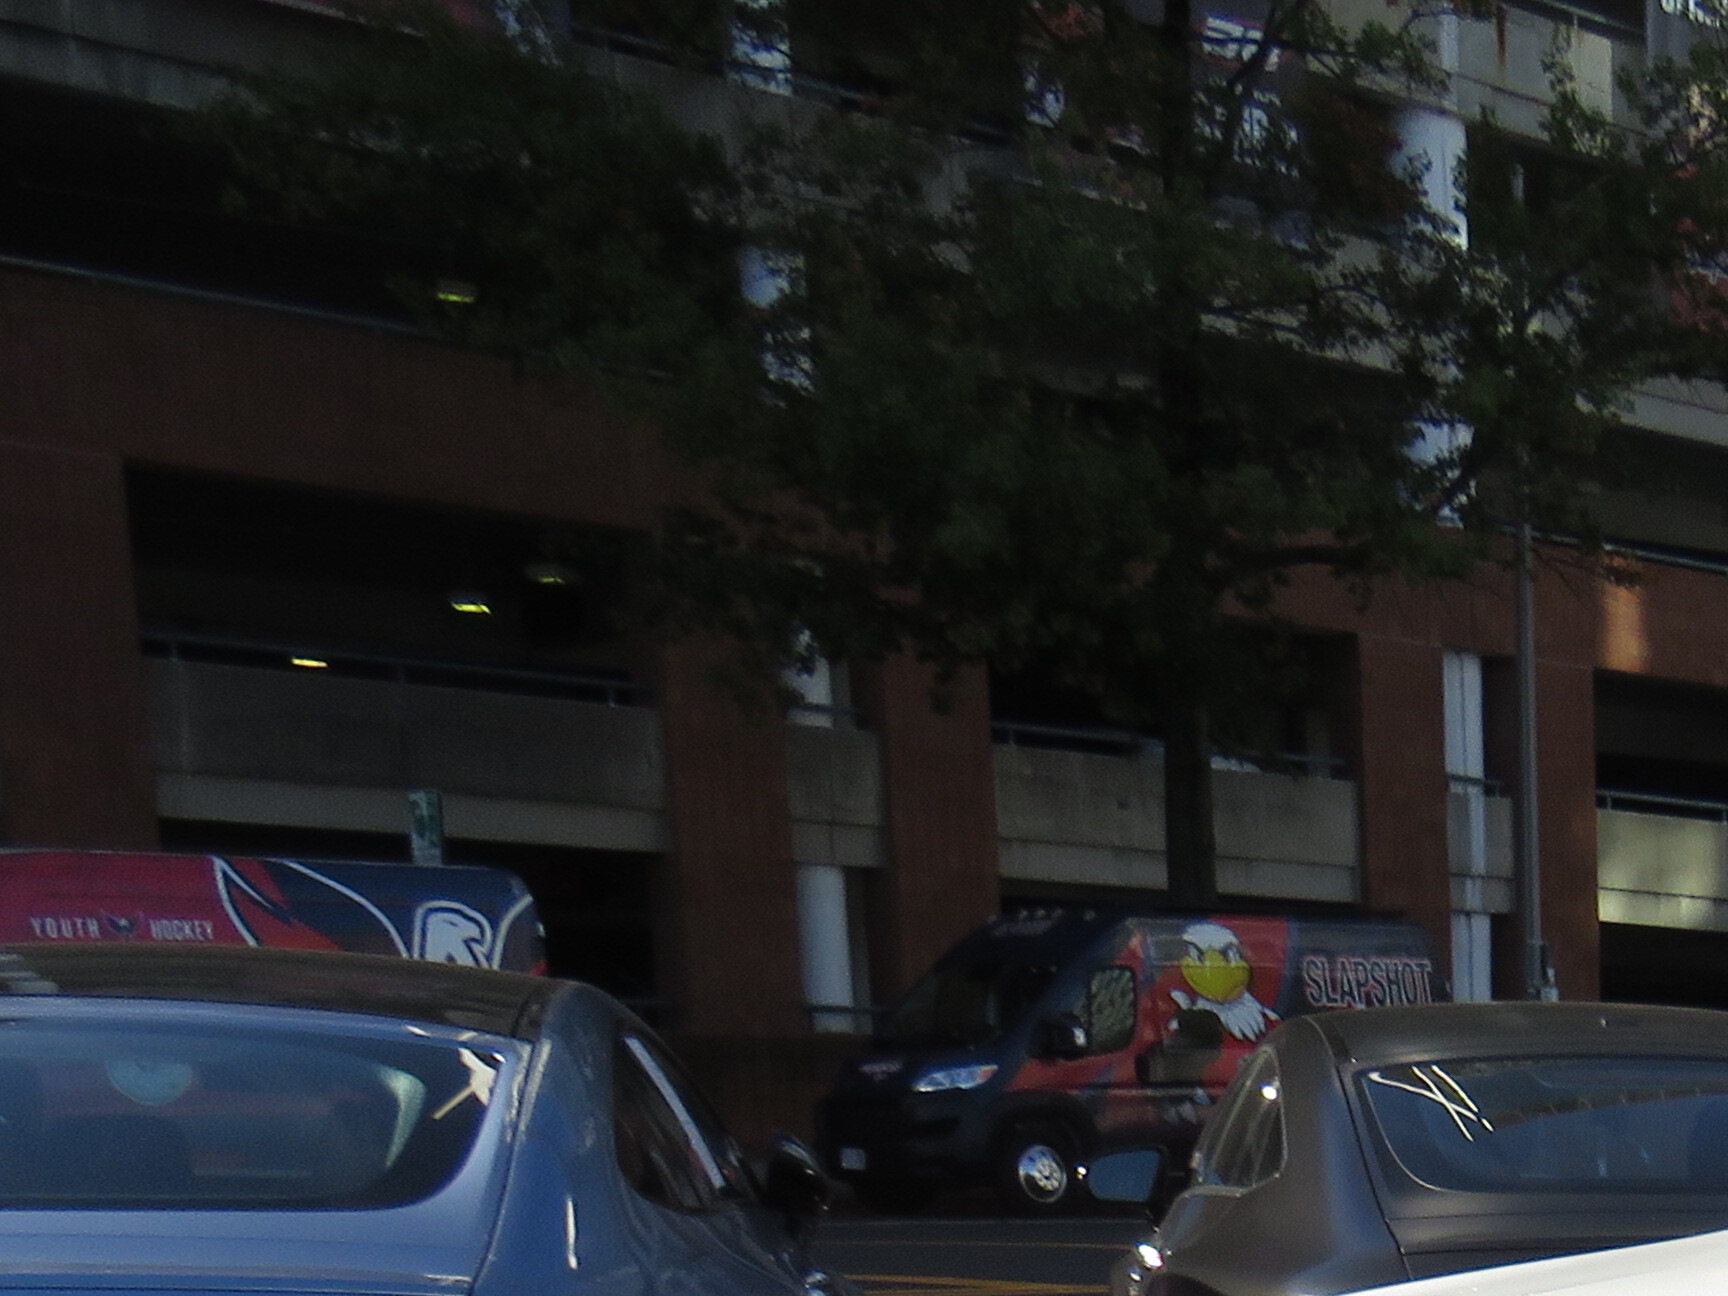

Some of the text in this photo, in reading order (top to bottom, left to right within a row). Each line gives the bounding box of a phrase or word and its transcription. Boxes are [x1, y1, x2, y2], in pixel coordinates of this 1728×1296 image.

[31, 915, 214, 941] YOUTH HOCKEY
[1303, 955, 1433, 1009] SLAPSHOT
